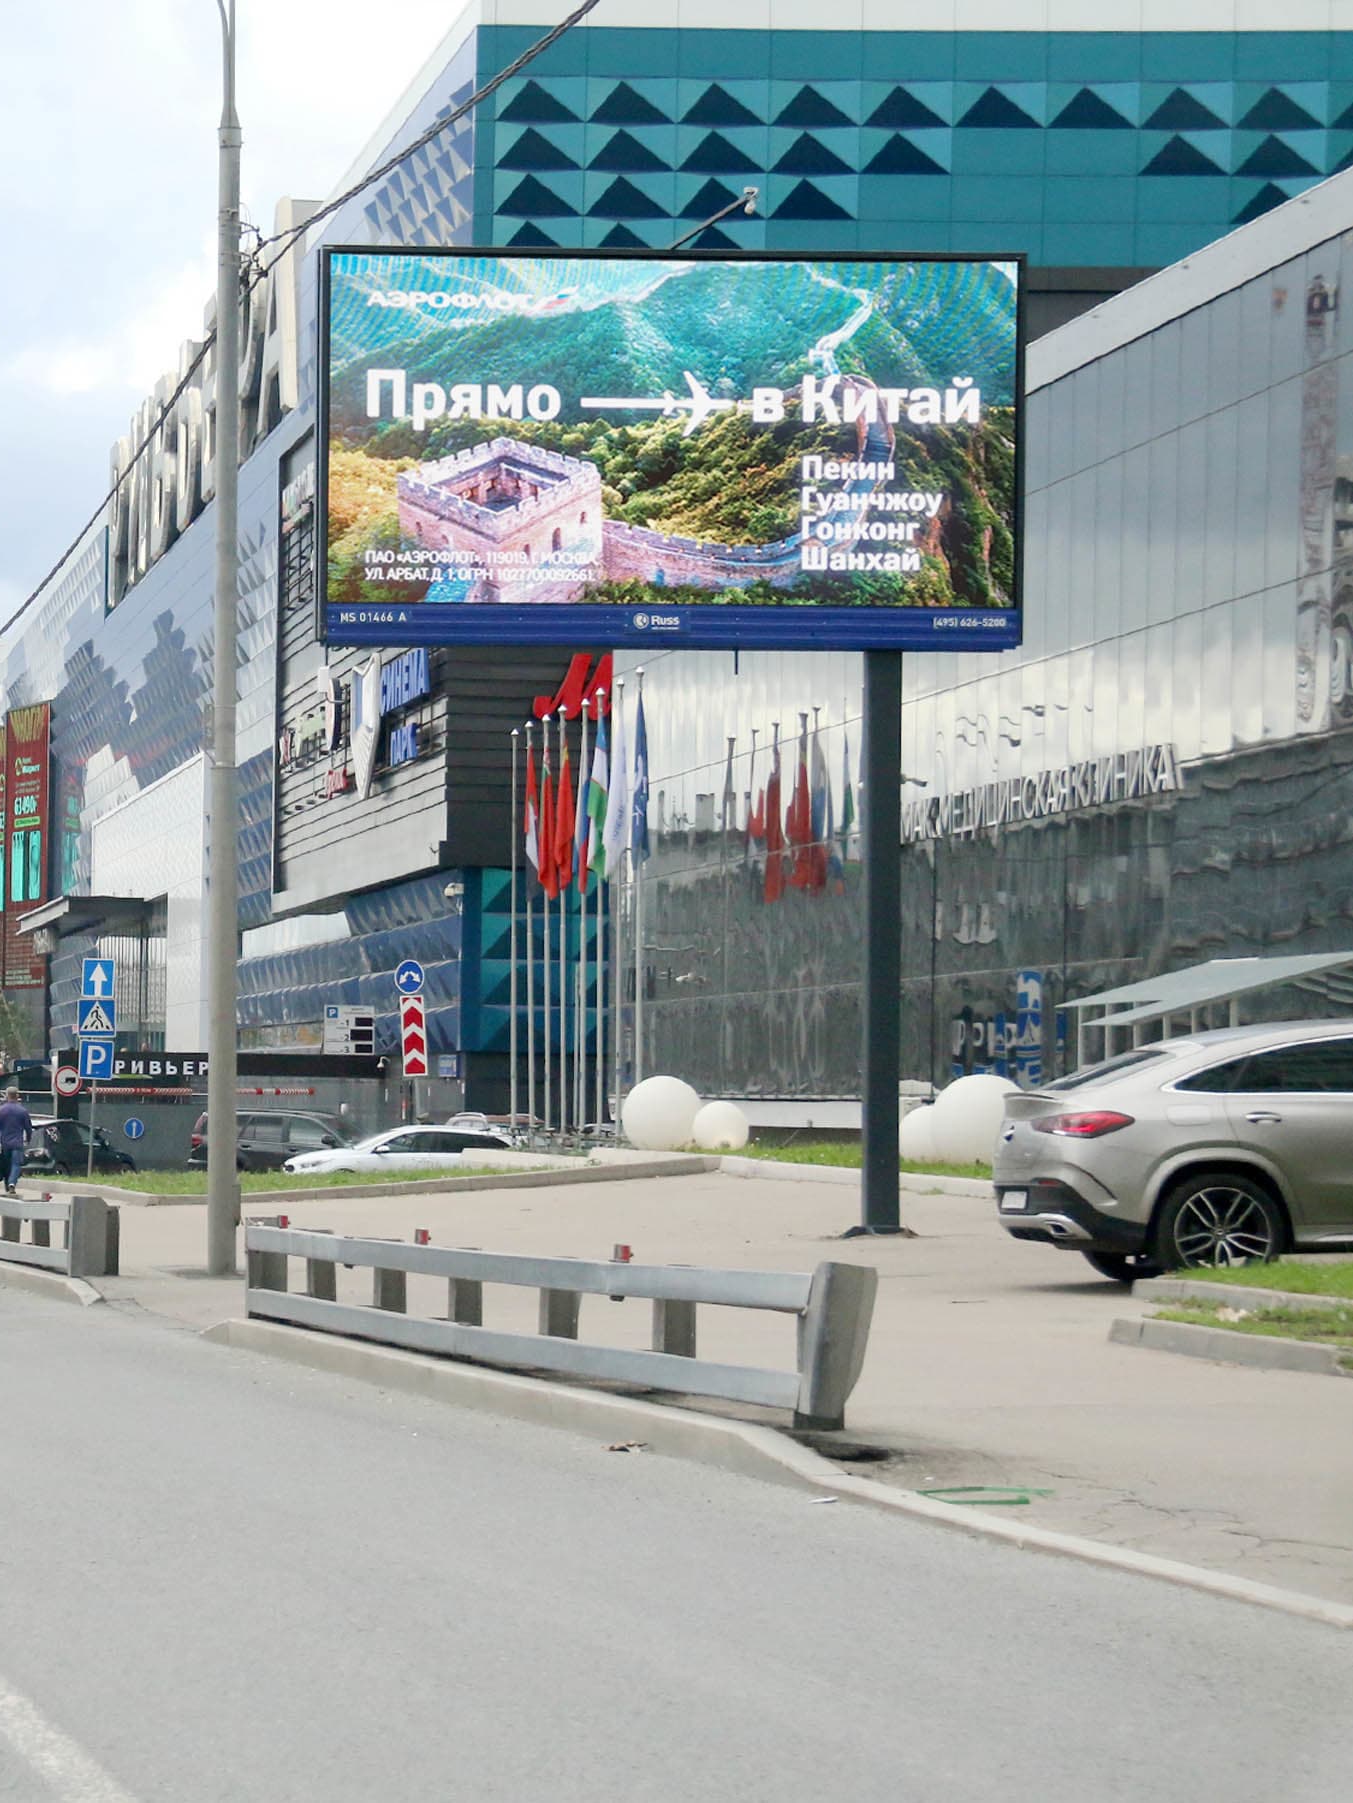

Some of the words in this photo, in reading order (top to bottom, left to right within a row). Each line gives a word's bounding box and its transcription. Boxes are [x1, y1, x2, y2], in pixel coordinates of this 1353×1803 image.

[367, 290, 535, 310] АЭРОФЛОТ
[366, 368, 562, 431] Прямо
[752, 386, 785, 423] в
[802, 374, 981, 424] Китай
[802, 455, 895, 480] Пекин
[801, 486, 943, 517] Гуанчжоу
[801, 515, 921, 541] Гонконг
[364, 550, 395, 564] ПАО
[800, 545, 921, 571] Шанхай
[457, 567, 493, 581] ОГРН
[340, 611, 357, 623] MS
[359, 611, 394, 623] 01466
[398, 611, 407, 623] A
[651, 615, 680, 626] Russ
[933, 616, 958, 629] (495)
[380, 647, 431, 717] СИНЕМА
[390, 722, 419, 767] ПАРК
[934, 766, 1071, 840] МЕДИЦИНСКАЯ
[1071, 743, 1183, 809] КЛИНИКА
[85, 1045, 107, 1075] P
[114, 1060, 209, 1076] РИВЬЕР
